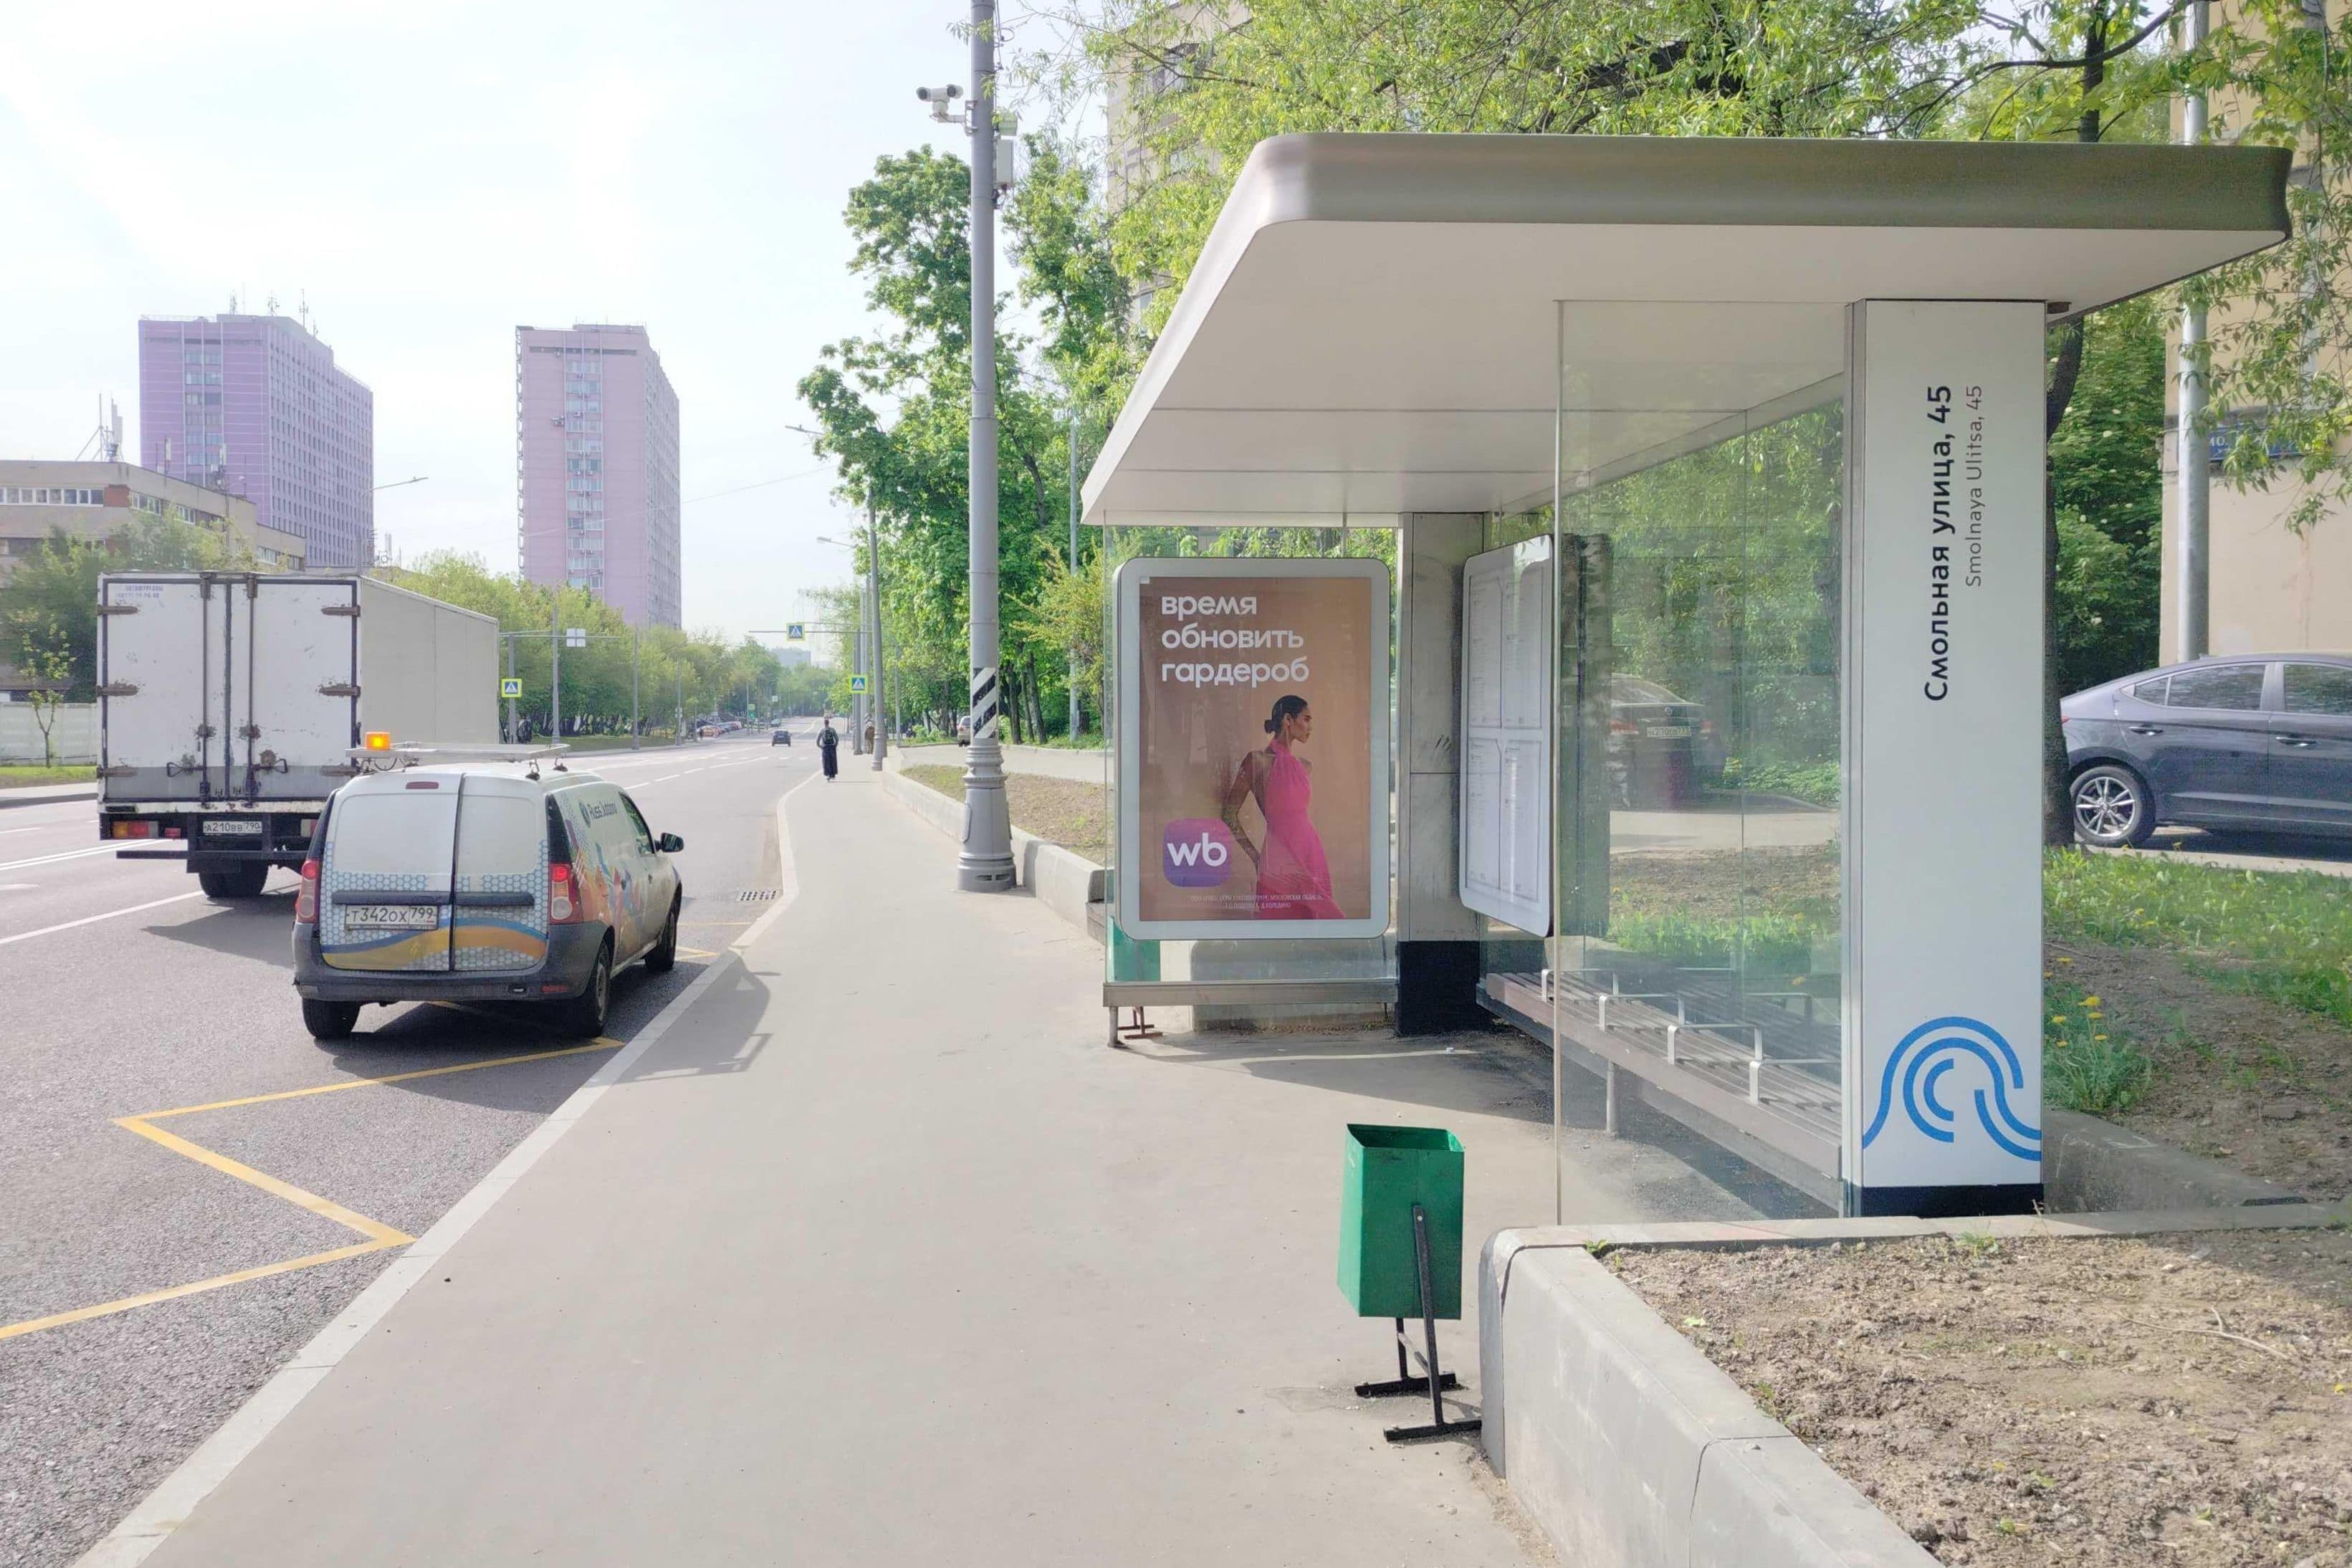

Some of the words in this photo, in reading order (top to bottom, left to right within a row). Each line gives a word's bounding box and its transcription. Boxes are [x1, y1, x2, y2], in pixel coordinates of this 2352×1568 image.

[1926, 386, 1951, 424] 45
[1966, 386, 1982, 411] 45
[1965, 416, 1984, 480] Ulitsa,
[1932, 434, 1956, 535] улица,
[1965, 487, 1986, 587] Smolnaya
[1161, 596, 1257, 621] время
[1923, 546, 1949, 701] Смольная
[1161, 622, 1304, 649] обновить
[1161, 655, 1310, 689] гардероб
[1166, 832, 1228, 866] wb
